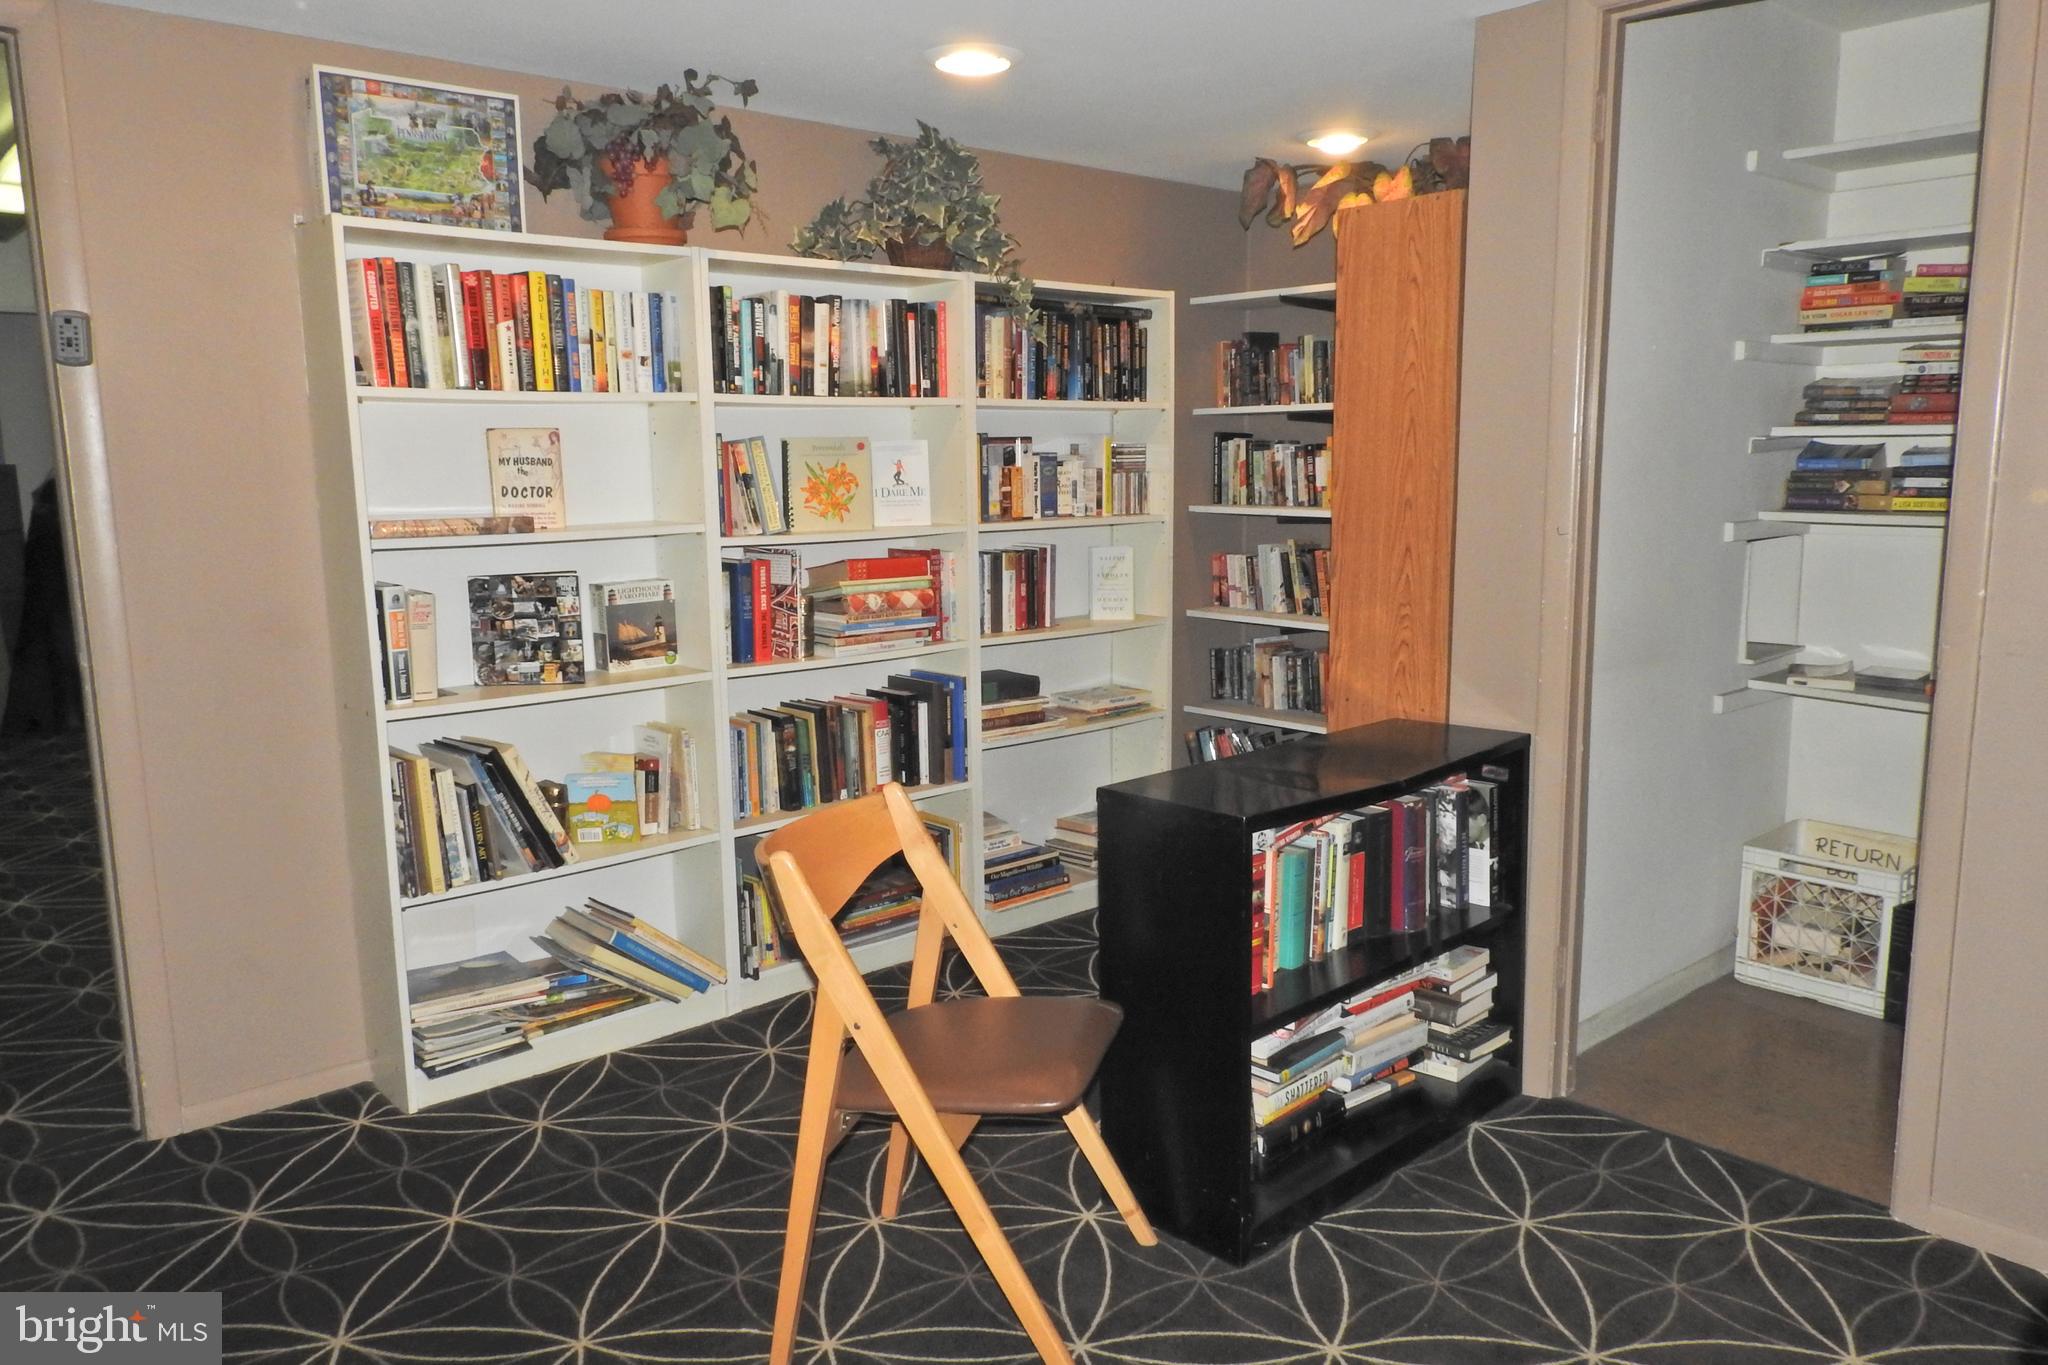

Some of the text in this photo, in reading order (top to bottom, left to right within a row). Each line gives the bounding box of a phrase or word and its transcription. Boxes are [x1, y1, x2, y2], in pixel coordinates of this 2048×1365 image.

[522, 313, 531, 338] SMITH
[498, 456, 511, 467] MY
[517, 466, 529, 477] the
[501, 486, 553, 499] DOCTOR
[881, 487, 909, 498] DARE
[478, 846, 487, 860] ART
[1815, 837, 1901, 871] RETURN
[1285, 1070, 1329, 1106] SHATTERED
